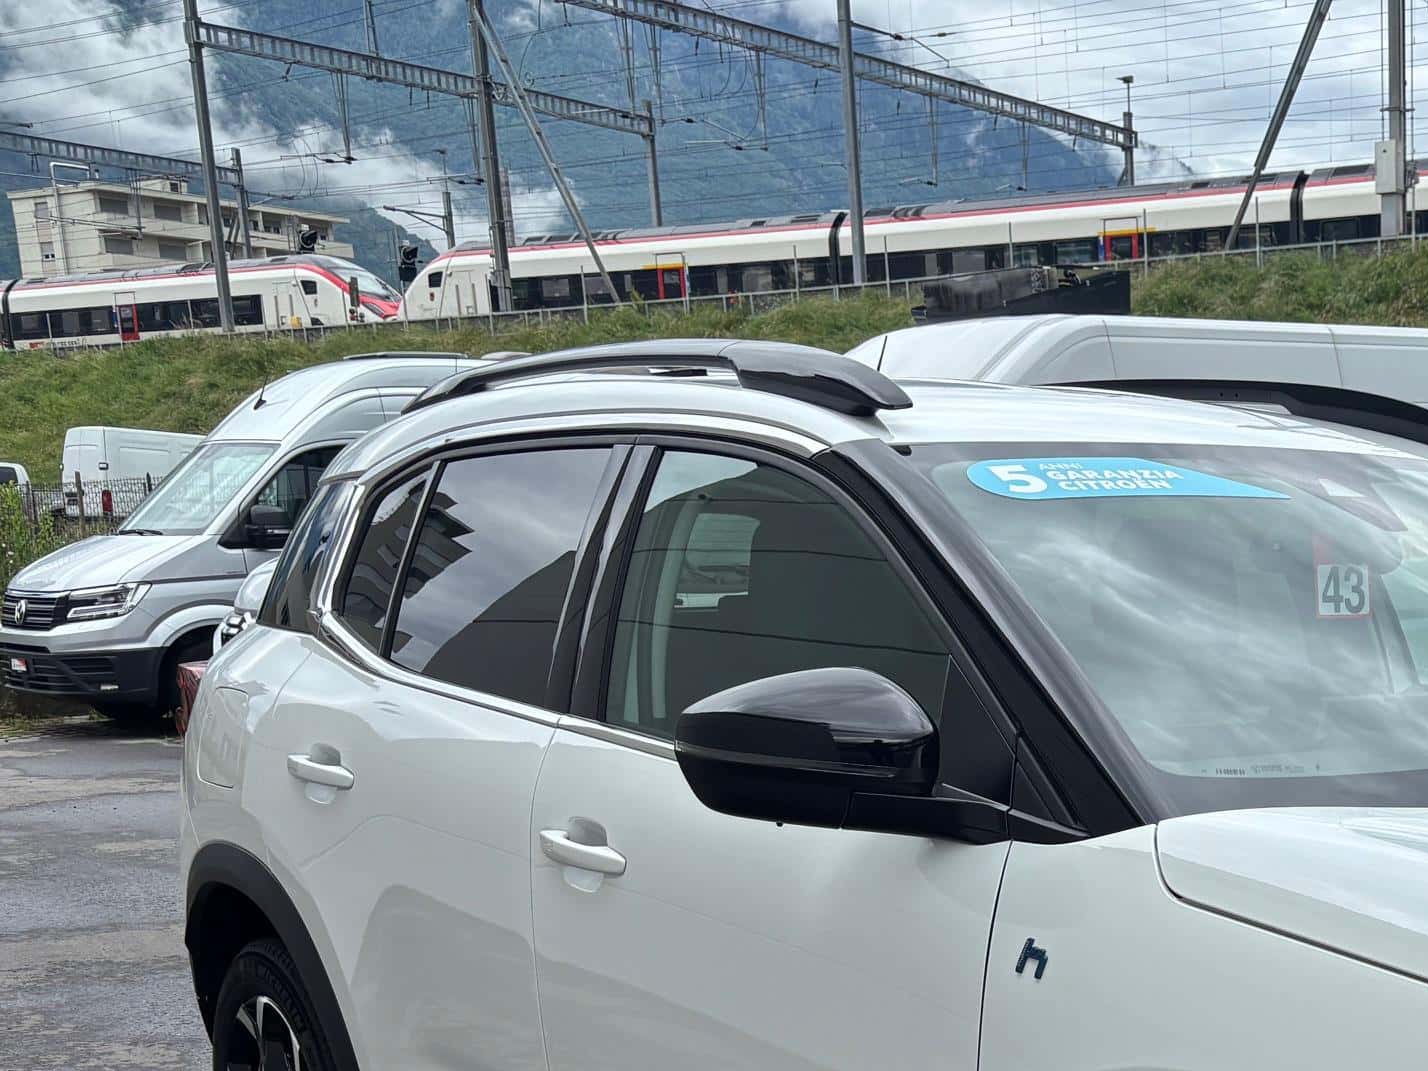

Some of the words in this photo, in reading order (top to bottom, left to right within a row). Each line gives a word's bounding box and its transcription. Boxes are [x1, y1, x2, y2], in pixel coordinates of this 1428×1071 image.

[987, 464, 1048, 493] 5
[1045, 470, 1184, 480] GARANZIA
[1321, 565, 1366, 614] 43
